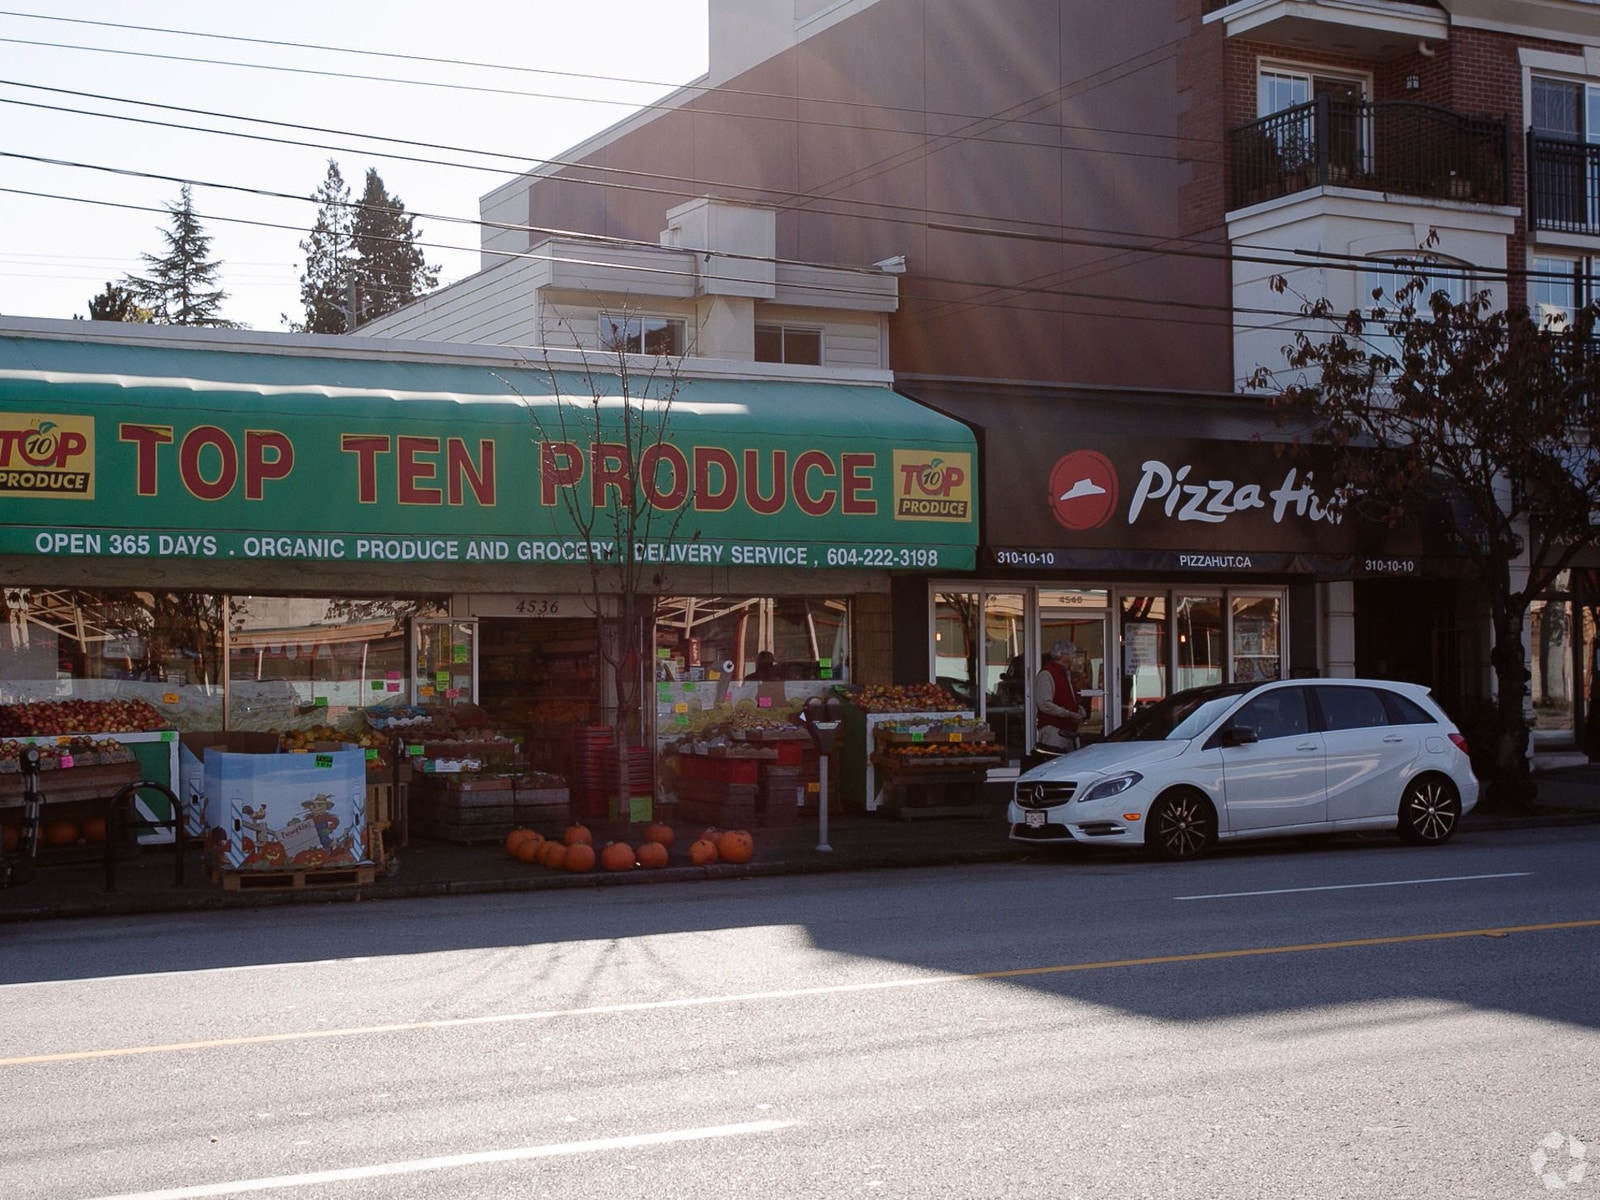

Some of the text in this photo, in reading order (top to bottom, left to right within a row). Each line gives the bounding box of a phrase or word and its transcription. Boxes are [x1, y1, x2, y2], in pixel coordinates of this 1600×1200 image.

[0, 428, 87, 468] TOP
[28, 437, 52, 455] 10
[119, 422, 878, 516] TOP TEN PRODUCE
[0, 472, 85, 489] PRODUCE
[901, 464, 965, 497] TOP
[923, 471, 941, 486] 10
[1128, 460, 1265, 525] Pizza
[902, 501, 965, 515] PRODUCE
[35, 532, 101, 554] OPEN
[109, 535, 150, 555] 365
[159, 535, 217, 556] DAYS
[243, 537, 345, 559] ORGANIC
[356, 540, 459, 560] PRODUCE
[466, 541, 510, 560] AND
[517, 541, 614, 561] GROCERY
[634, 543, 724, 563] DELIVERY
[731, 545, 808, 565] SERVICE
[827, 548, 938, 567] 604-222-3198
[997, 552, 1054, 564] 310-10-10
[1180, 555, 1252, 568] PIZZAHUT.CA
[1365, 560, 1414, 571] 310-10-10
[516, 600, 559, 614] 4536
